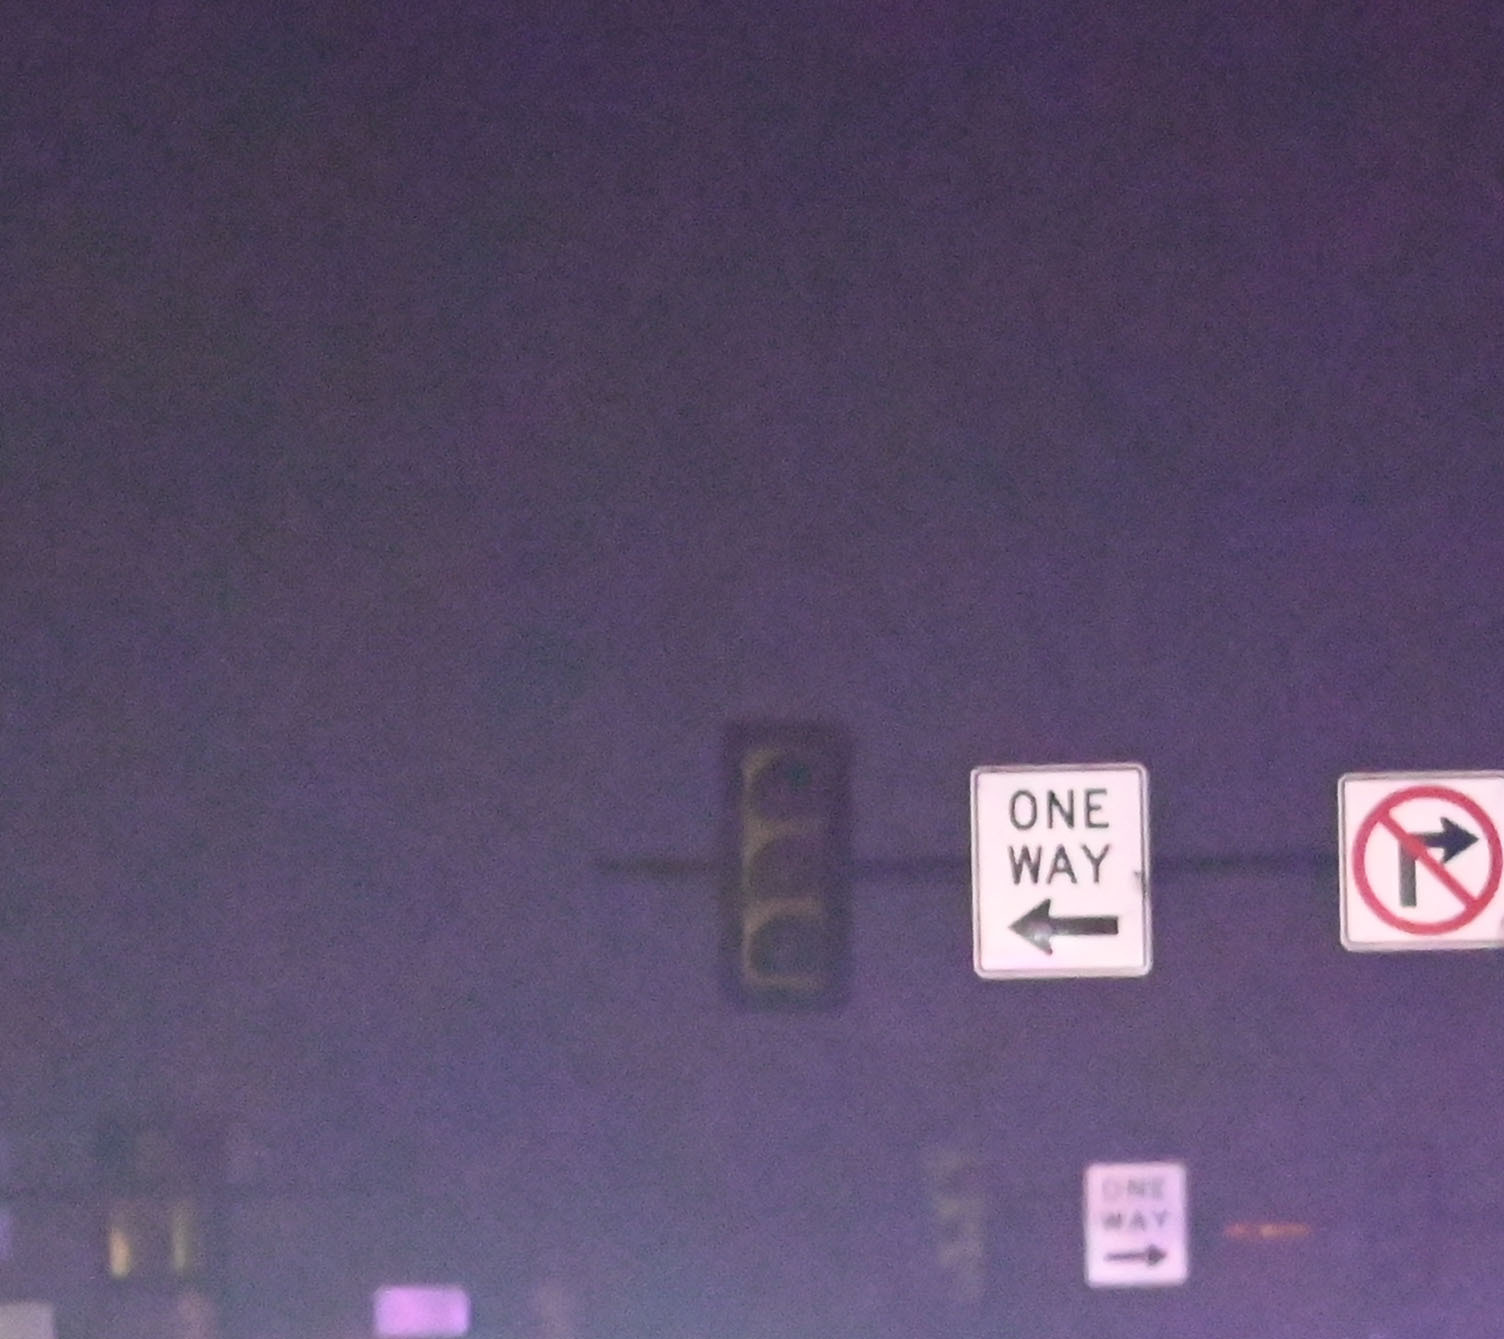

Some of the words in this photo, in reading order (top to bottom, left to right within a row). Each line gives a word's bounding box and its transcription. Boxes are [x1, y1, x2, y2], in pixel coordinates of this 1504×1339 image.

[1009, 789, 1110, 830] ONE
[1008, 844, 1112, 885] WAY
[1101, 1178, 1164, 1201] ONE
[1101, 1209, 1170, 1232] WAY
